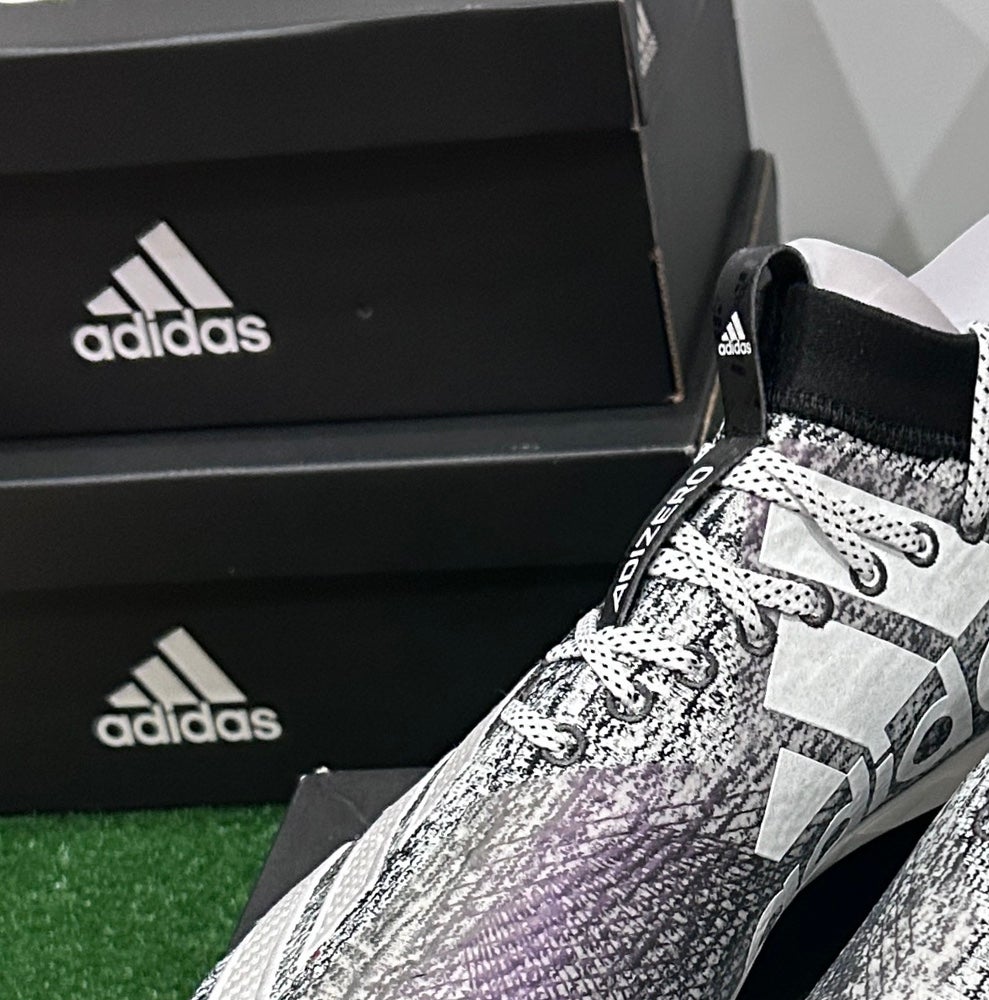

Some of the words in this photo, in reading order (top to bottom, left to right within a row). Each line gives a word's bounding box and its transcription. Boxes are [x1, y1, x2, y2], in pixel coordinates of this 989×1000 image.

[73, 309, 271, 362] adidas
[718, 338, 752, 356] adidas
[612, 466, 714, 613] ADIZERO
[97, 700, 282, 747] adidas
